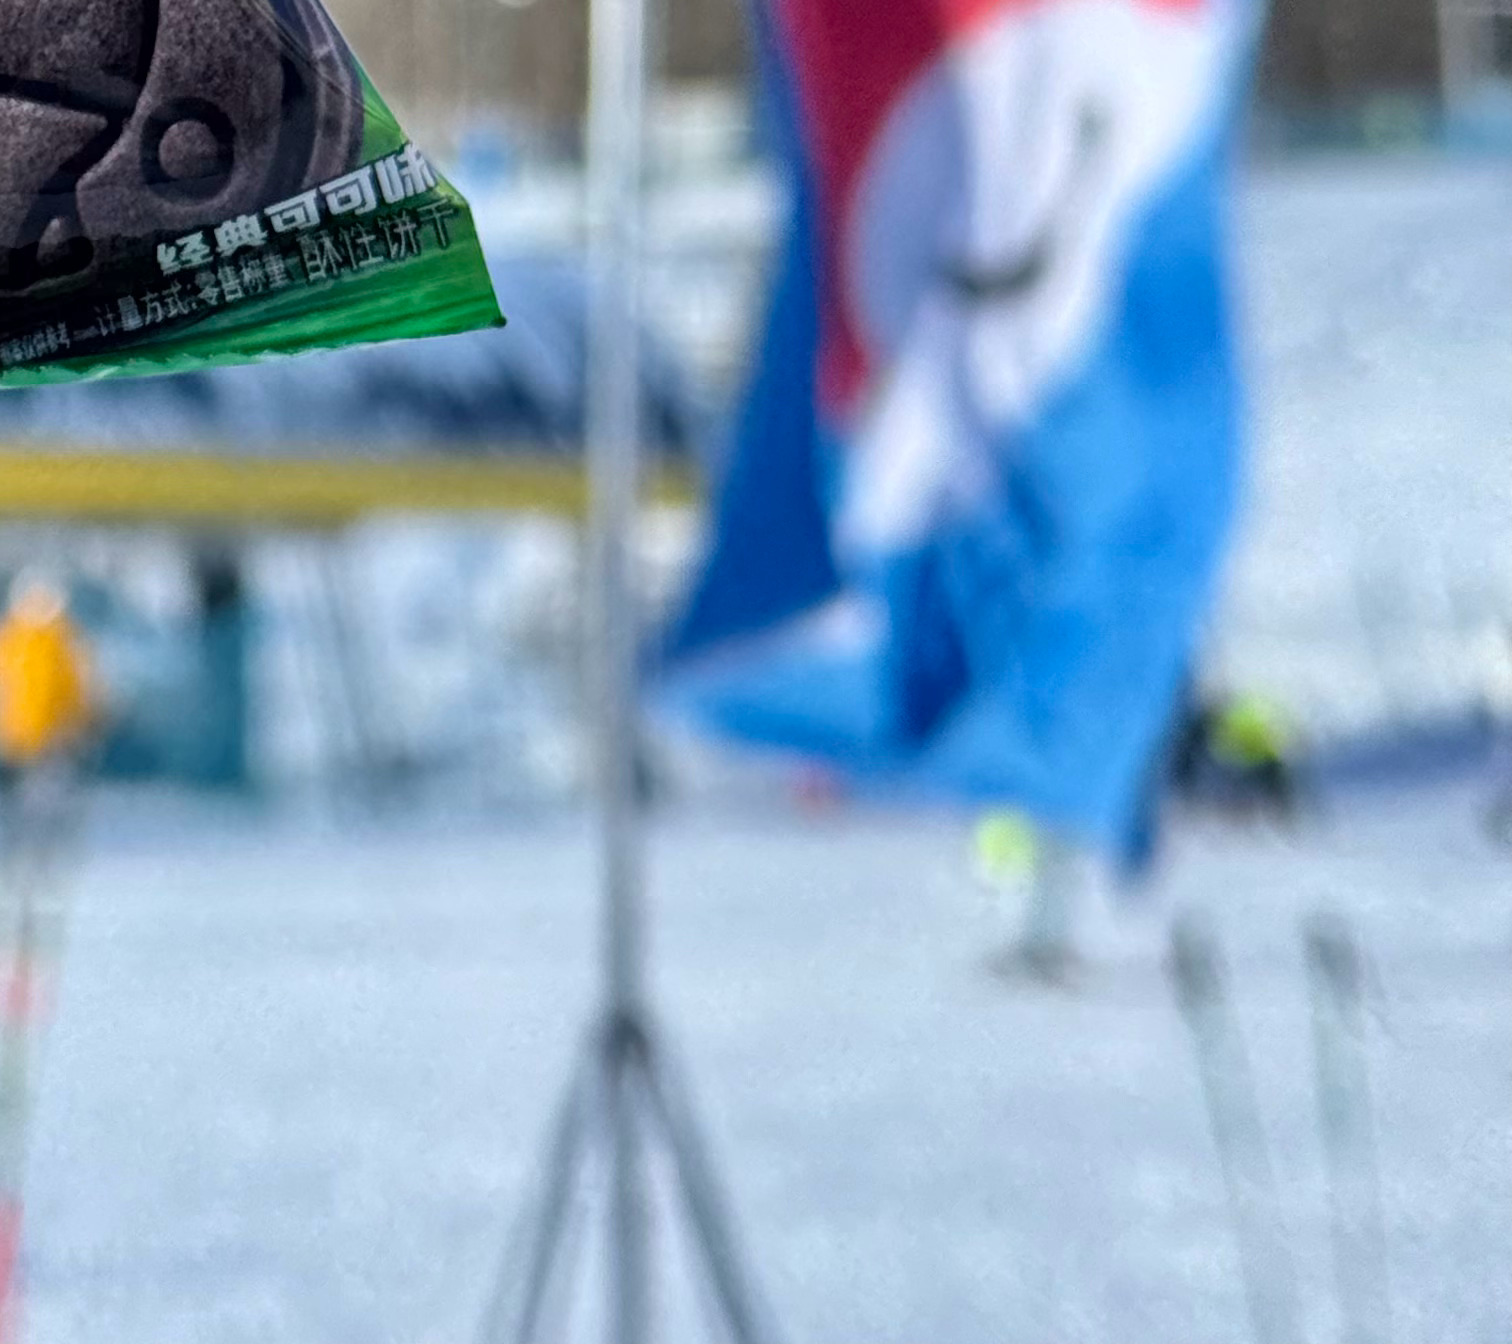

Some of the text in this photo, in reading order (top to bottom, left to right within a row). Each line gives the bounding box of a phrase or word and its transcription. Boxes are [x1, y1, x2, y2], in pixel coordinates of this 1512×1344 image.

[156, 144, 440, 273] 经典可可味
